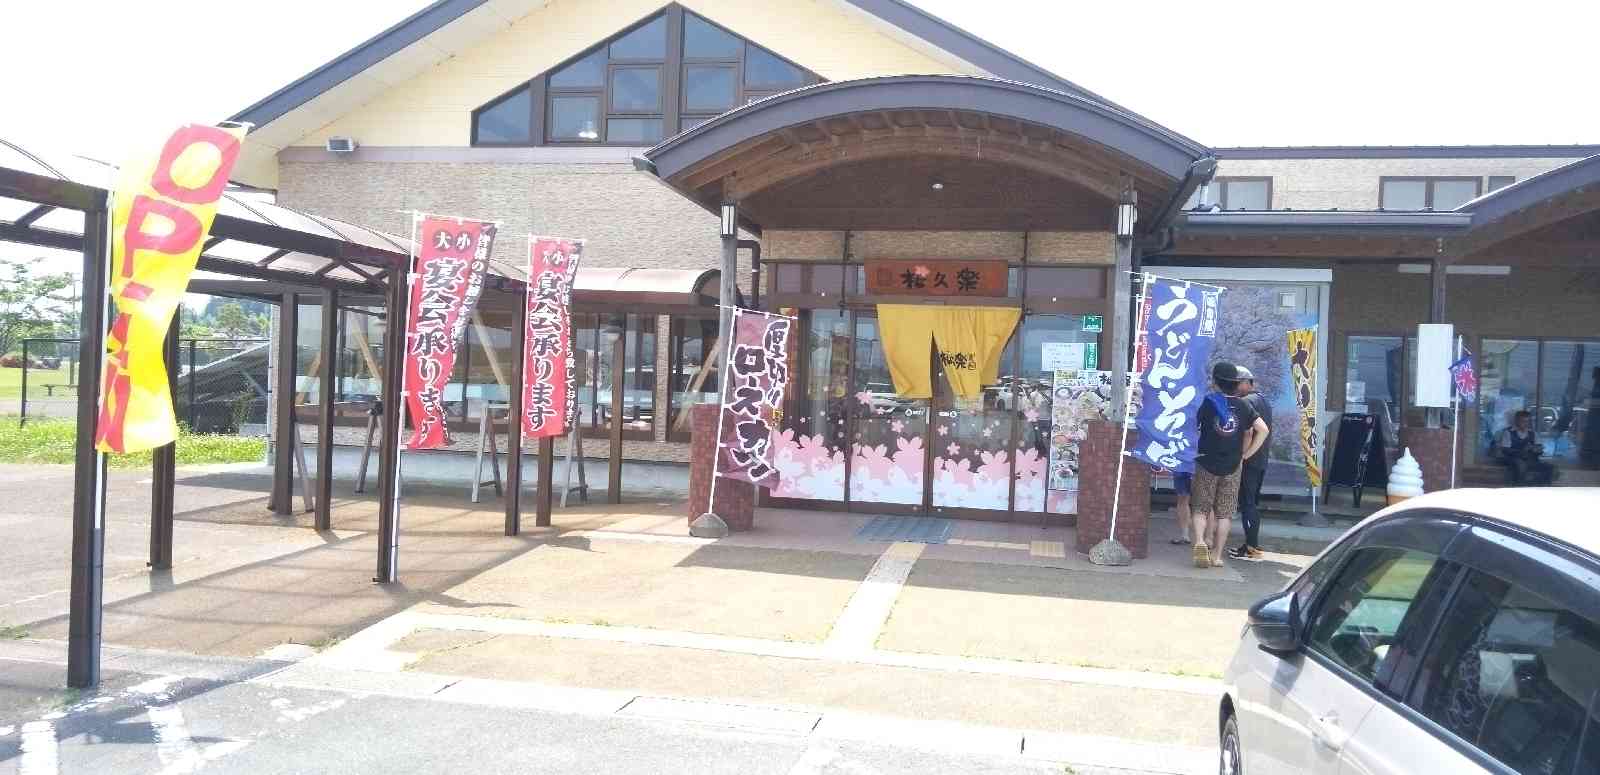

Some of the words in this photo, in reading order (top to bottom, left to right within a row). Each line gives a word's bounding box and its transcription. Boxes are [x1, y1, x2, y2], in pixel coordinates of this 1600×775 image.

[528, 271, 563, 432] 宴会承ります
